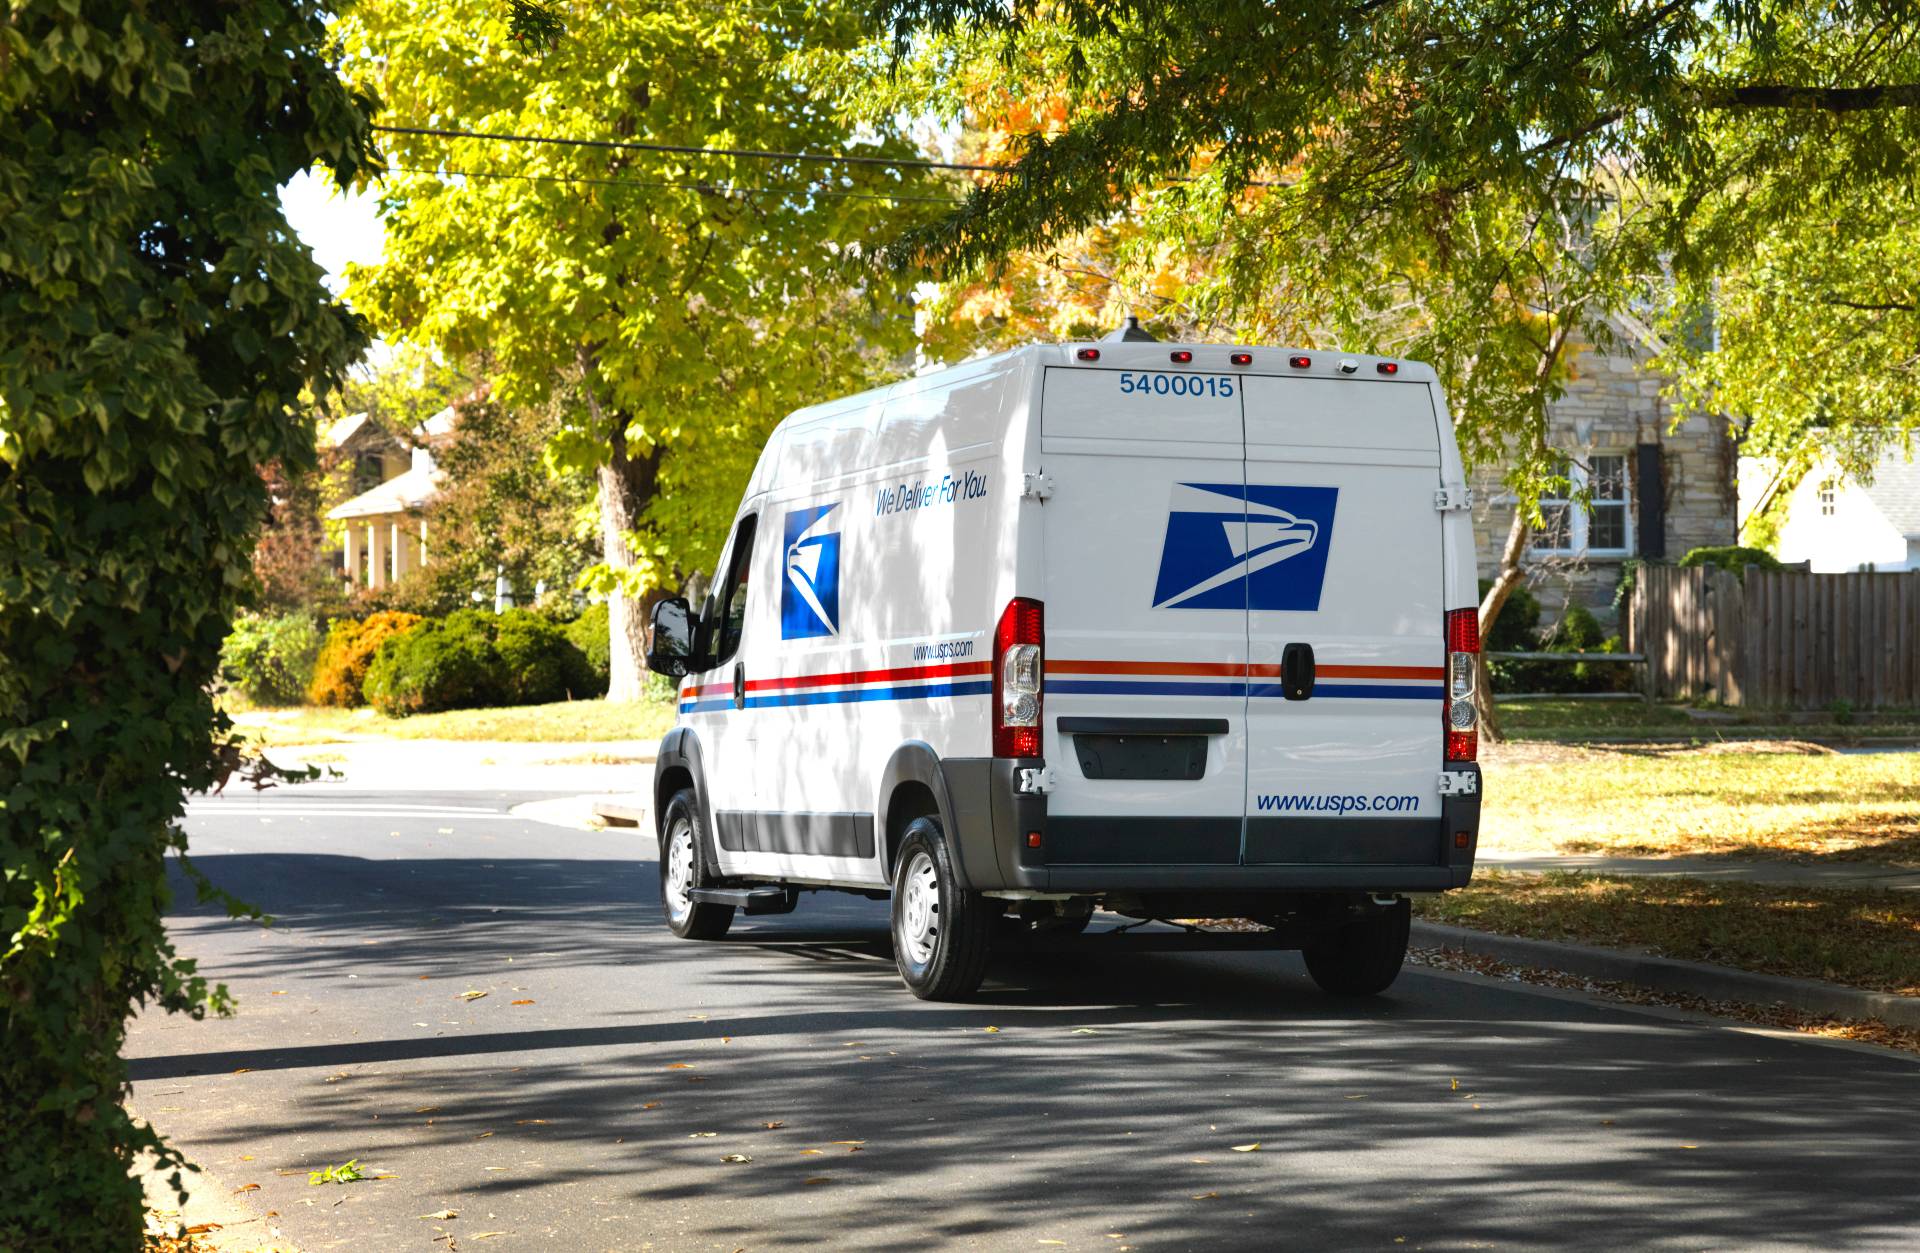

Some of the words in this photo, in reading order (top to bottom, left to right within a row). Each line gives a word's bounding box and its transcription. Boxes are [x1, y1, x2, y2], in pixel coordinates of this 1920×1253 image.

[1120, 373, 1233, 397] 5400015
[876, 487, 895, 516] We
[895, 480, 938, 512] Deliver
[939, 474, 962, 503] For
[962, 470, 987, 500] You.
[913, 640, 973, 663] www.usps.com
[1257, 795, 1419, 815] www.usps.com
